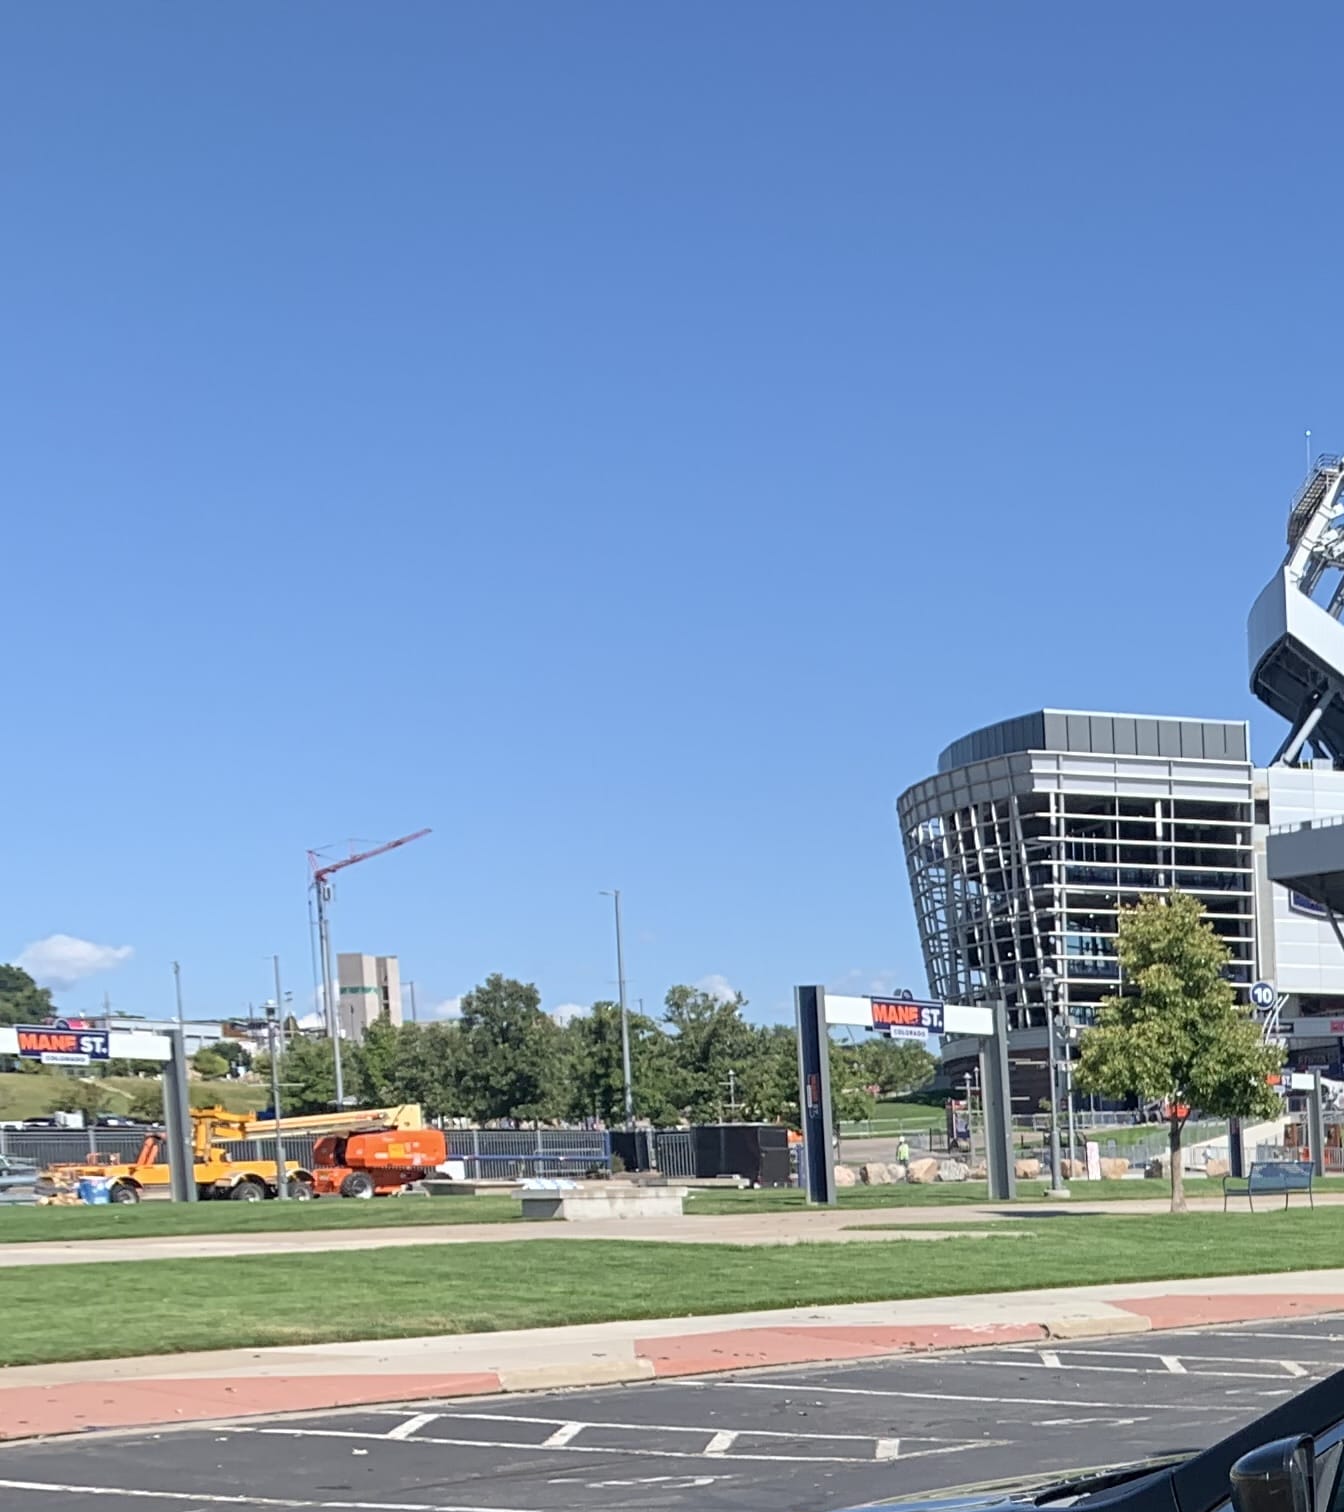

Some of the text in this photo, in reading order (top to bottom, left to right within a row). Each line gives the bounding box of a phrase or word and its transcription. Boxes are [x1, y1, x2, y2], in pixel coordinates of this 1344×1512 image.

[1254, 987, 1273, 1004] 10
[873, 1003, 943, 1027] MANE ST.
[18, 1033, 107, 1053] MANE ST.
